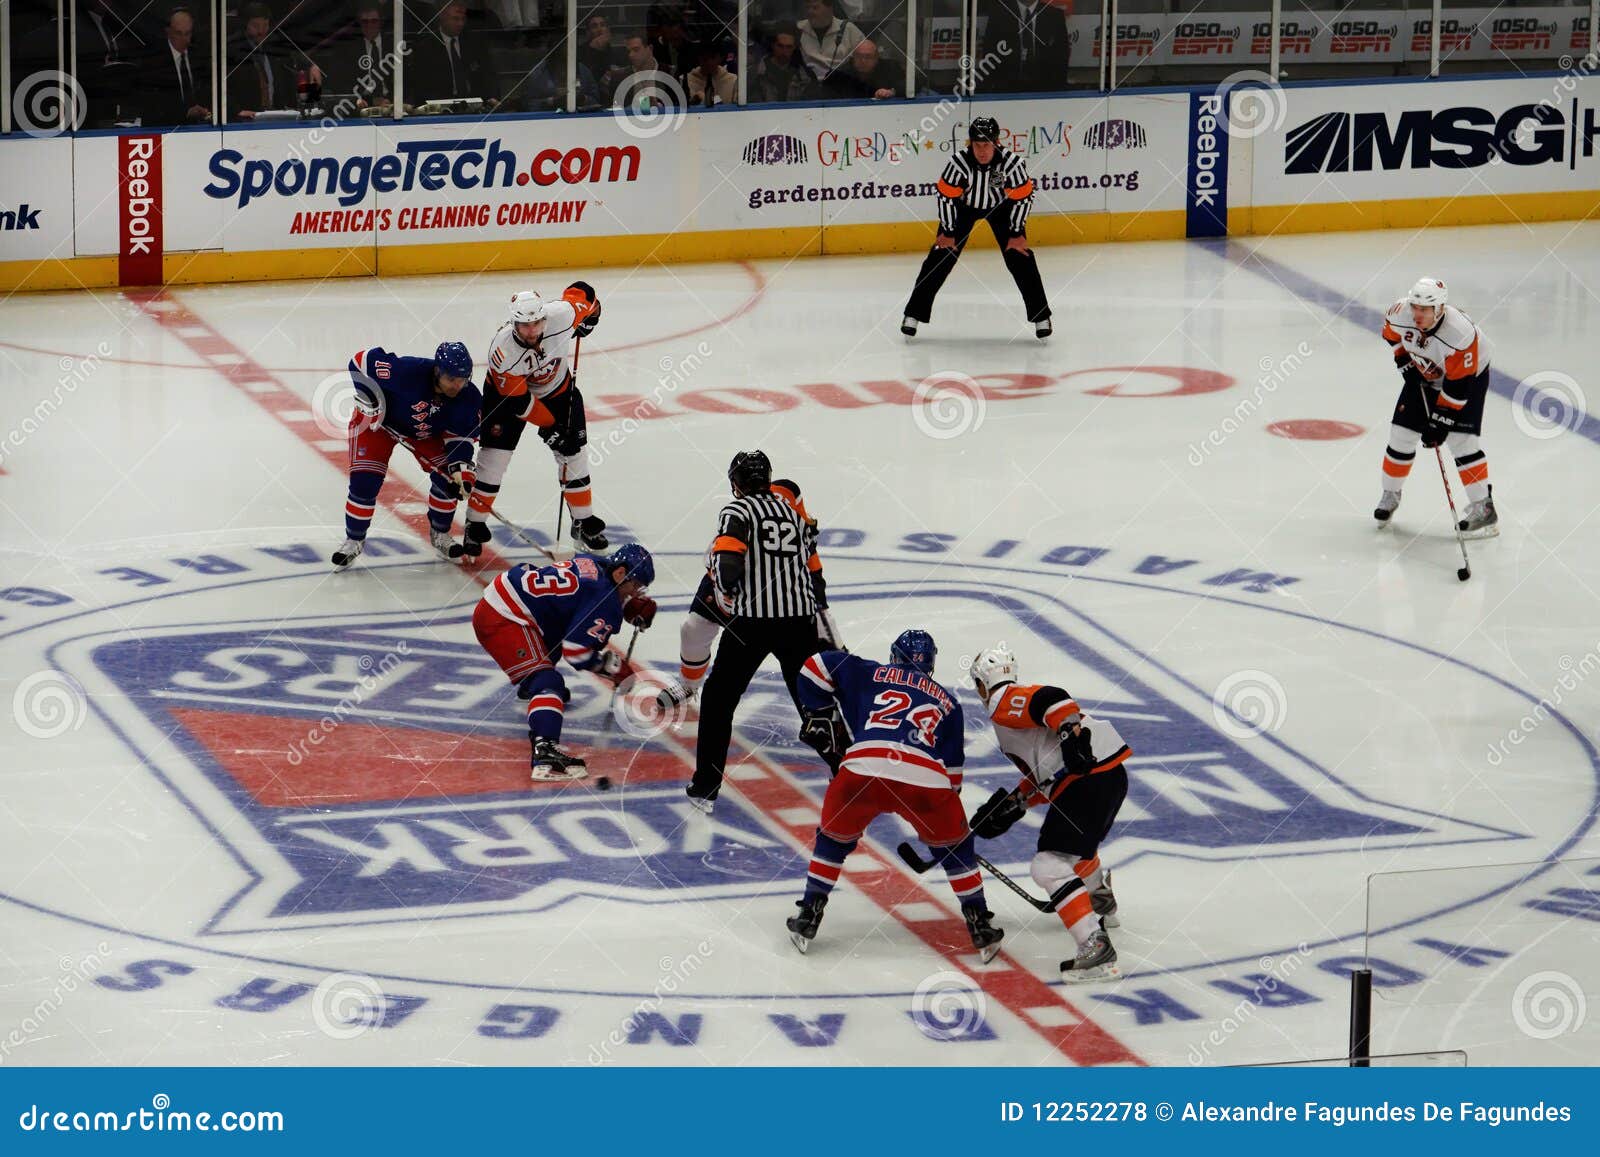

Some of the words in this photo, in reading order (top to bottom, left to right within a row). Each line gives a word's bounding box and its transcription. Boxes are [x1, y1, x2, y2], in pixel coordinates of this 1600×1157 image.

[1174, 23, 1221, 37] 1050
[1332, 21, 1378, 36] 1050
[1490, 33, 1551, 50] ESPN
[1492, 19, 1538, 33] 1050
[1172, 38, 1234, 55] ESPN
[1330, 37, 1391, 53] ESPN
[817, 129, 922, 170] GARDEN
[999, 121, 1072, 159] REAMS
[1196, 95, 1222, 207] Reebok
[1353, 104, 1565, 172] MSG
[204, 139, 641, 208] SpongeTech.com
[128, 137, 154, 255] Reebok
[290, 209, 391, 234] AMERICA'S
[397, 205, 490, 230] CLEANING
[496, 201, 587, 226] COMPANY
[1463, 352, 1473, 368] 2
[762, 520, 798, 553] 32
[816, 526, 1302, 593] MADISO
[864, 689, 944, 748] 24
[1007, 695, 1027, 718] 10
[297, 802, 785, 878] YORK
